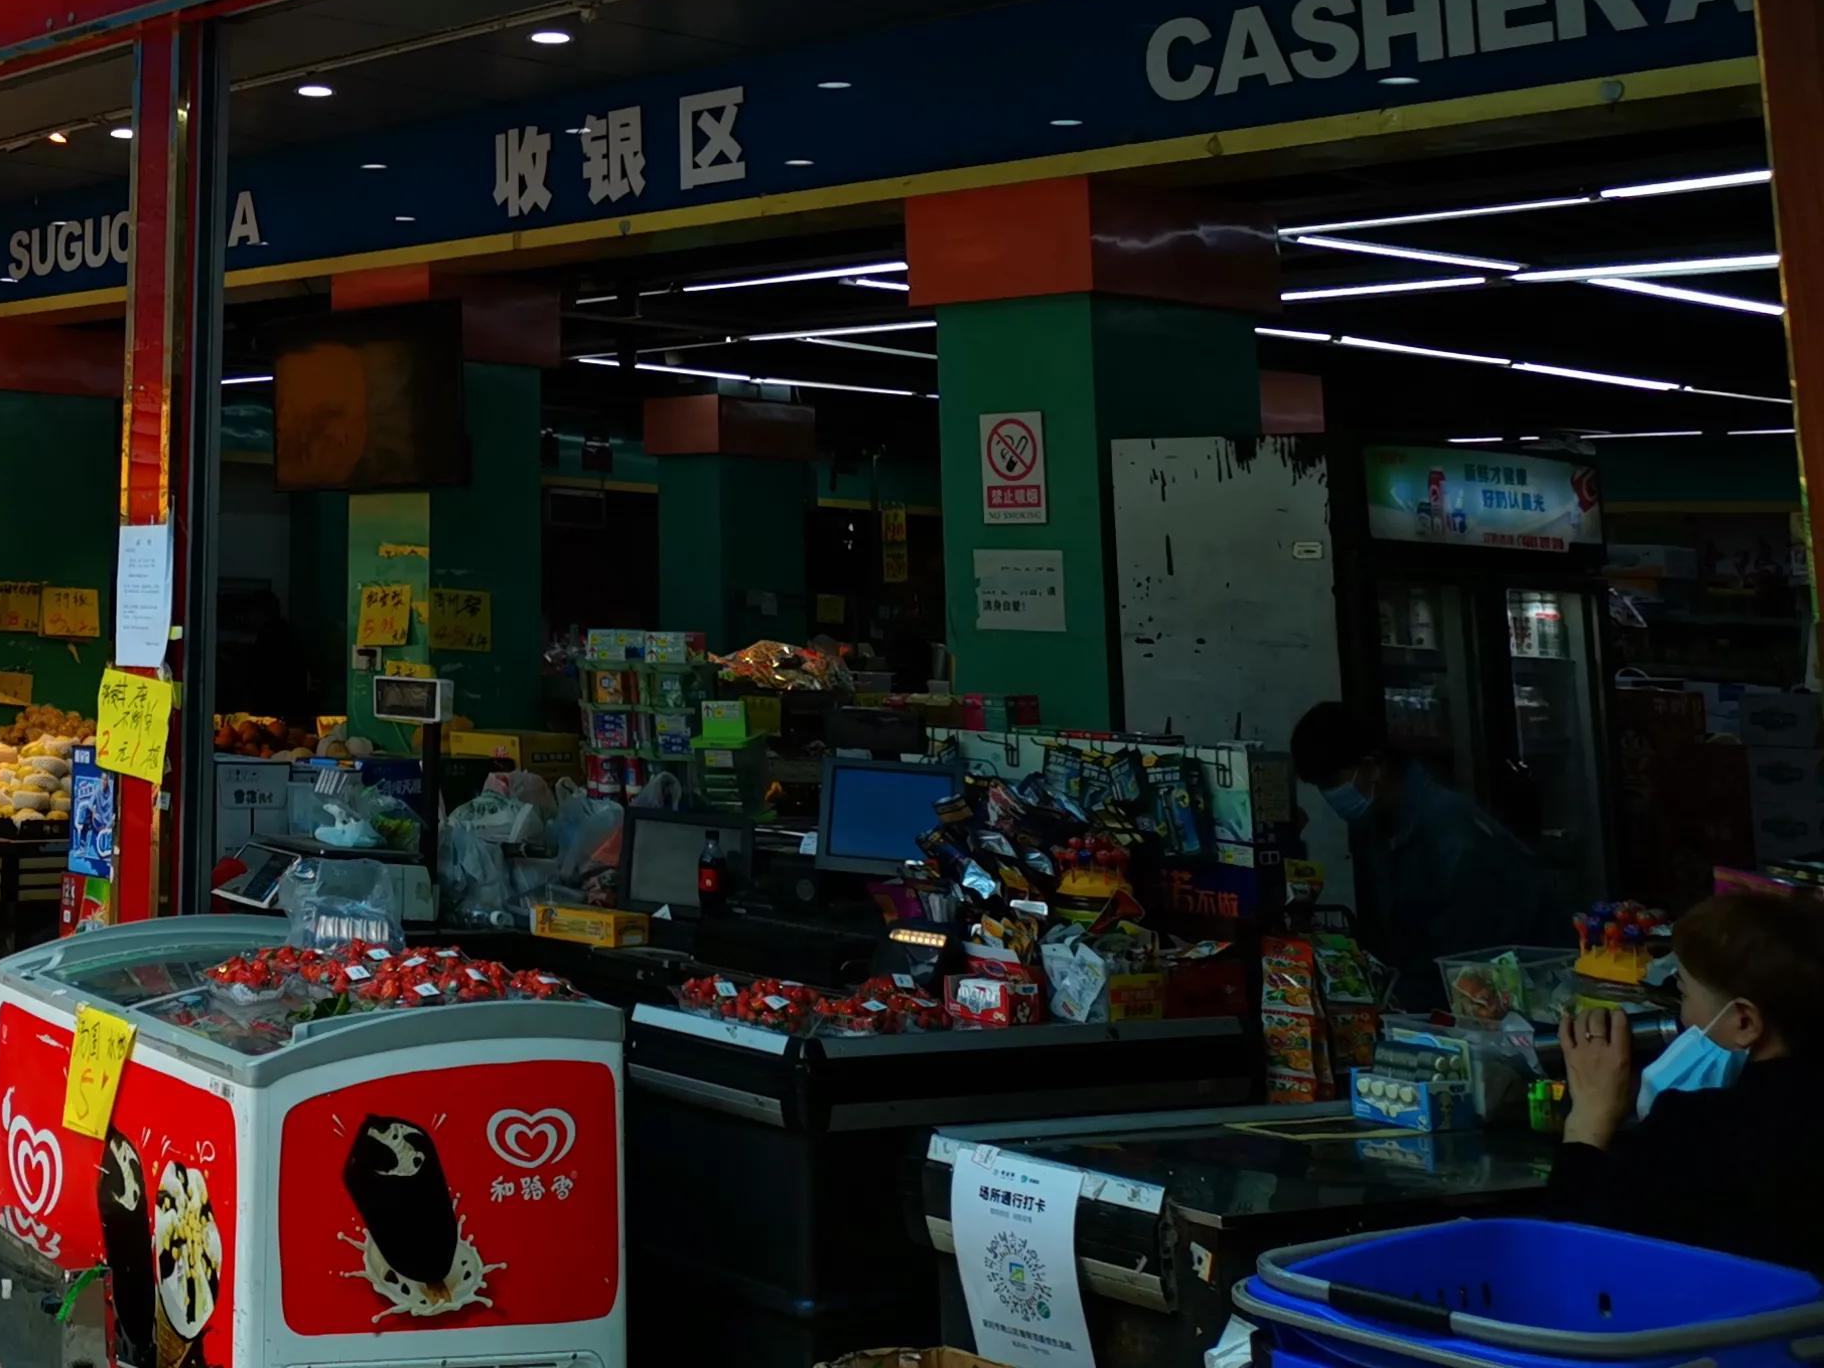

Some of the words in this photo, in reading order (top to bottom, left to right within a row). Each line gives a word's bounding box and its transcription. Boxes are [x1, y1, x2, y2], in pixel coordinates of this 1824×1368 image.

[492, 85, 746, 218] 收银区
[991, 488, 1038, 506] 禁止吸烟
[490, 1175, 574, 1203] 和路雪
[979, 1185, 1046, 1214] 场所通行打卡
